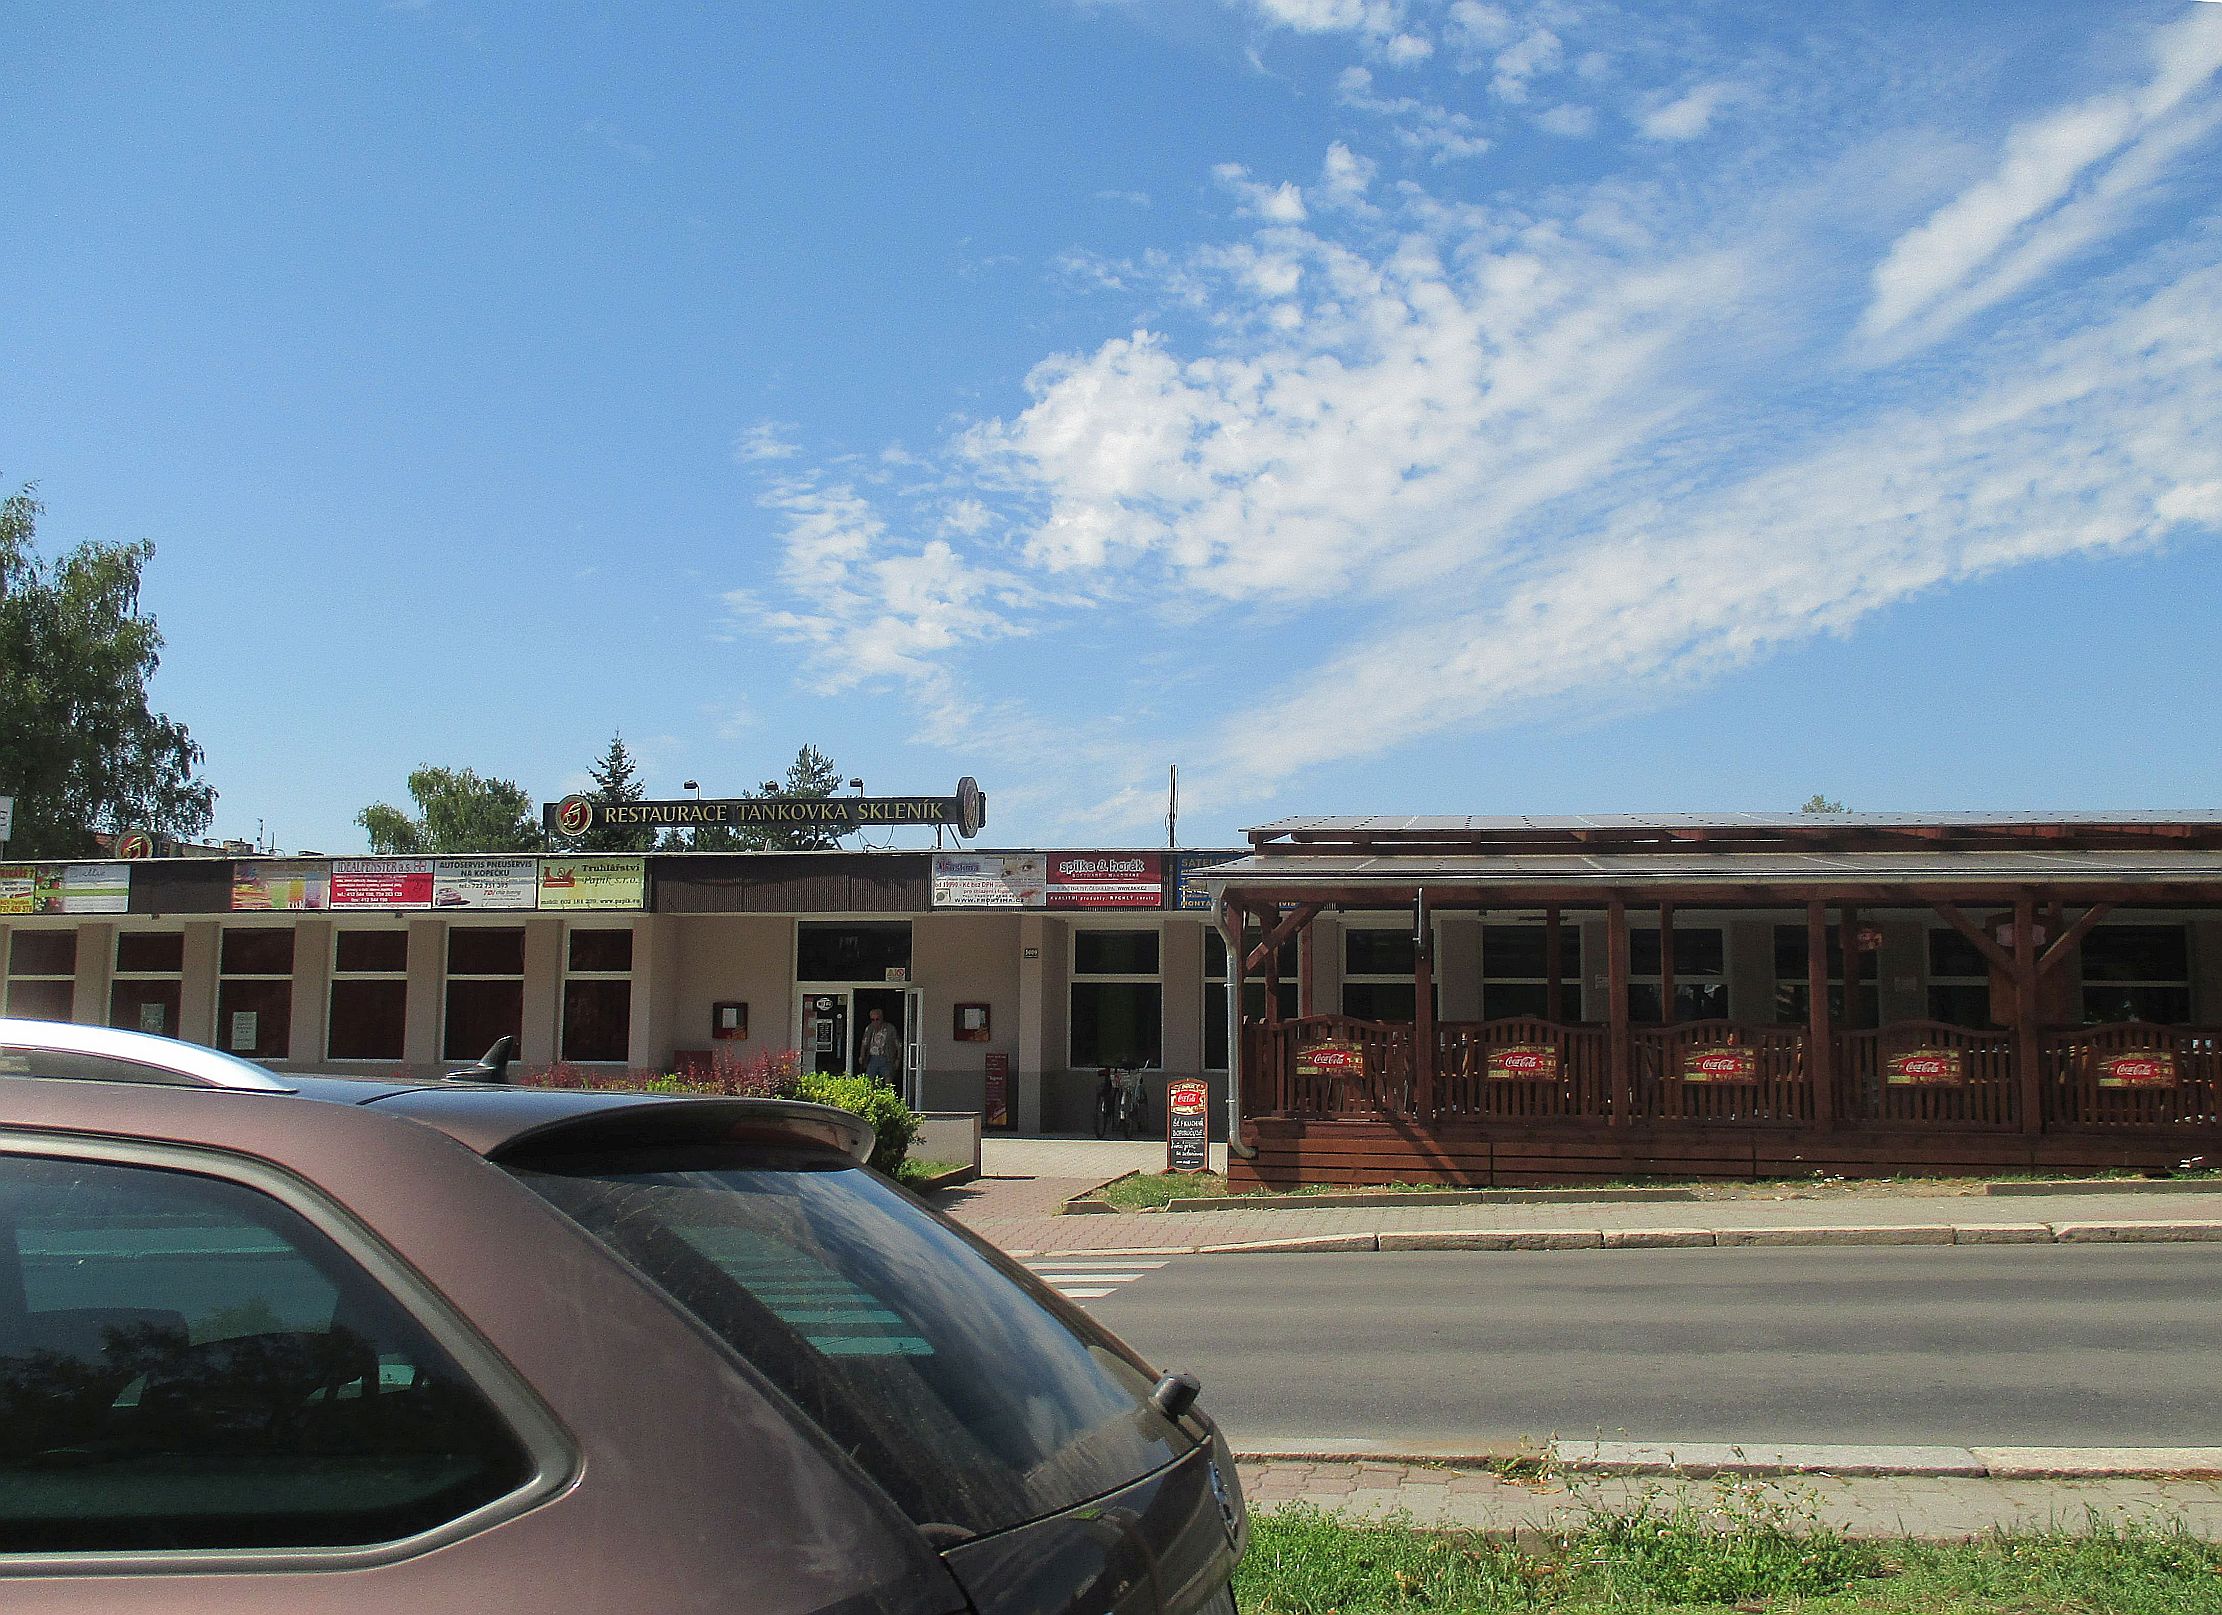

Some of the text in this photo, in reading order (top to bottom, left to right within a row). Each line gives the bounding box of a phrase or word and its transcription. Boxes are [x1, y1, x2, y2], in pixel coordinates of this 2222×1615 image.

[605, 799, 943, 823] RESTAURACE TANKOVKA SKLENÍK
[337, 861, 396, 873] IDEALFENSTER
[487, 860, 532, 868] PNEUSERVIS
[582, 864, 640, 872] Truhlářství
[1060, 859, 1096, 874] spilka
[1097, 859, 1108, 871] &
[474, 869, 509, 877] KOPEČKU
